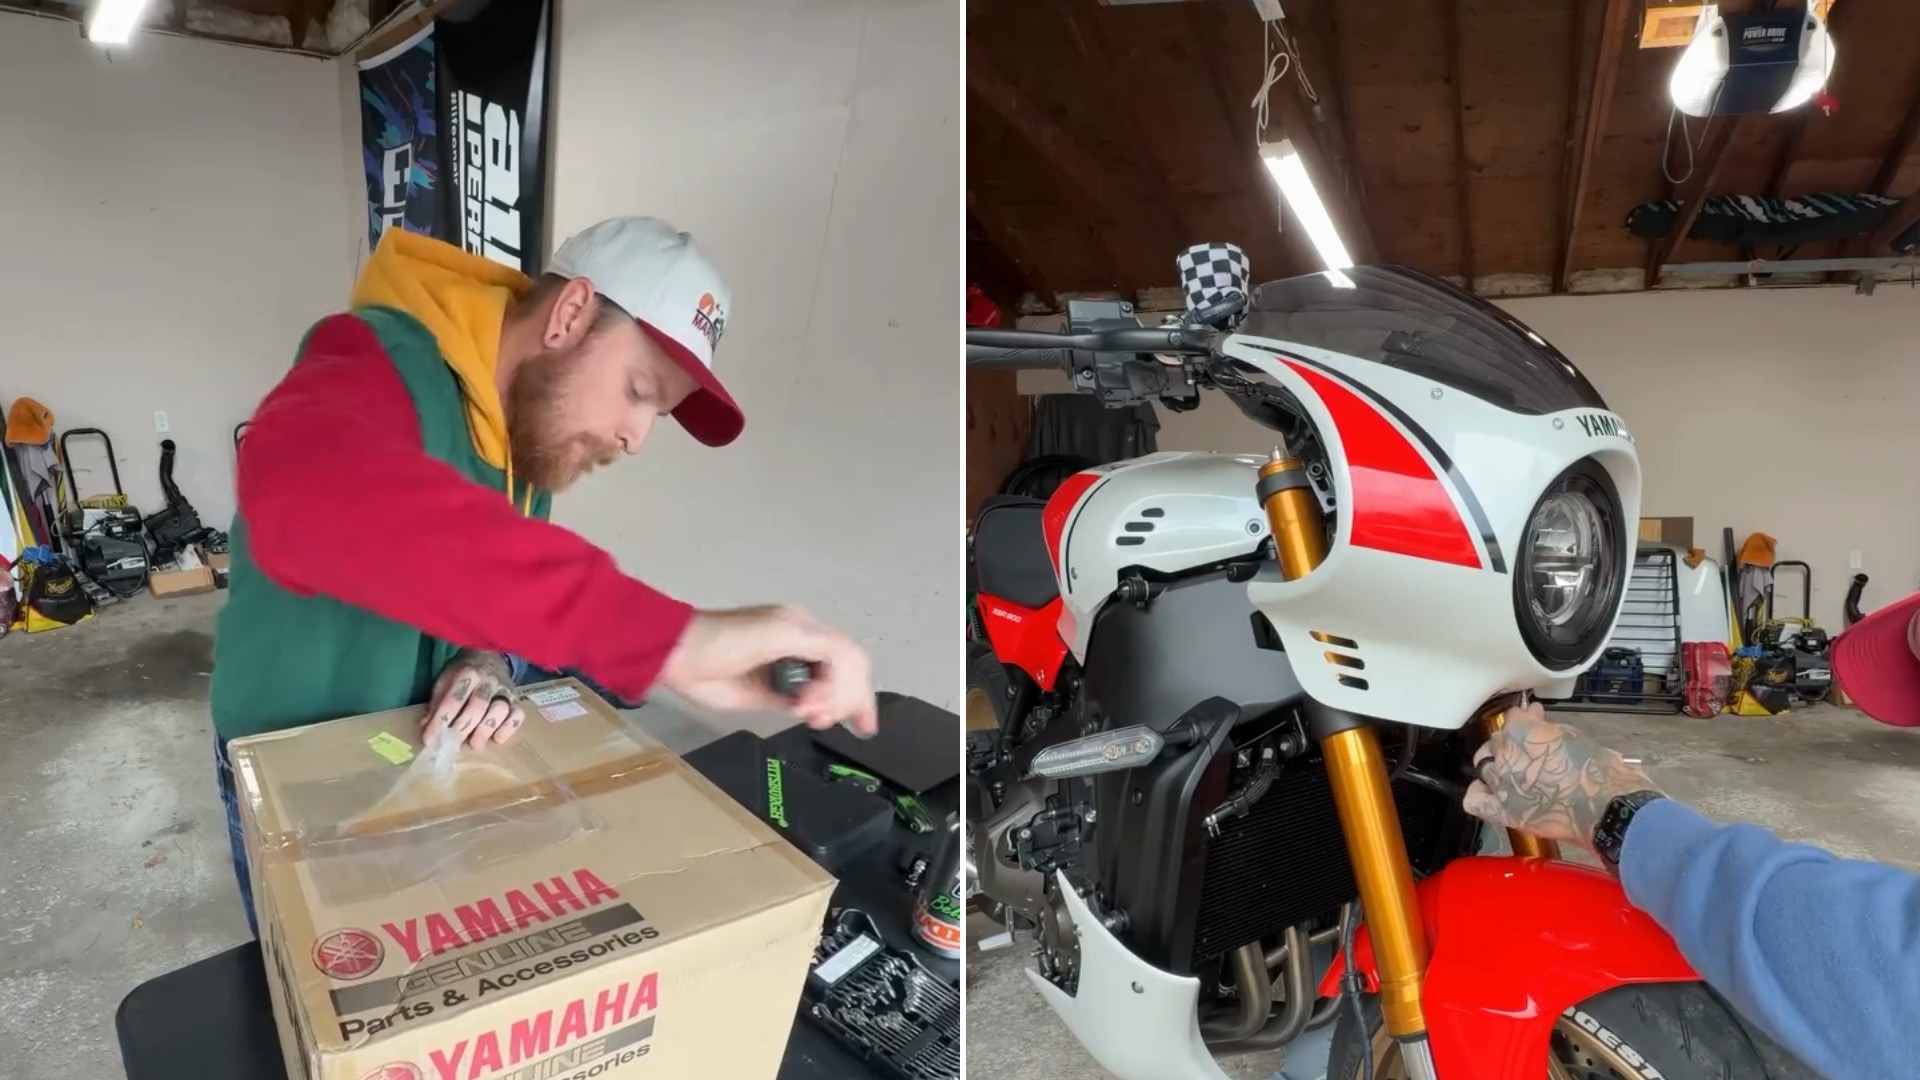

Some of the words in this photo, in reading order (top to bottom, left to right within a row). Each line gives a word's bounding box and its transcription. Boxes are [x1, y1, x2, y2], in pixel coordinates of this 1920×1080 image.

[381, 868, 620, 963] YAMAHA
[395, 921, 594, 994] GENUINE
[340, 1000, 434, 1041] Parts
[442, 988, 469, 1007] &
[478, 925, 660, 997] Accessories
[429, 972, 658, 1080] YAMAHA
